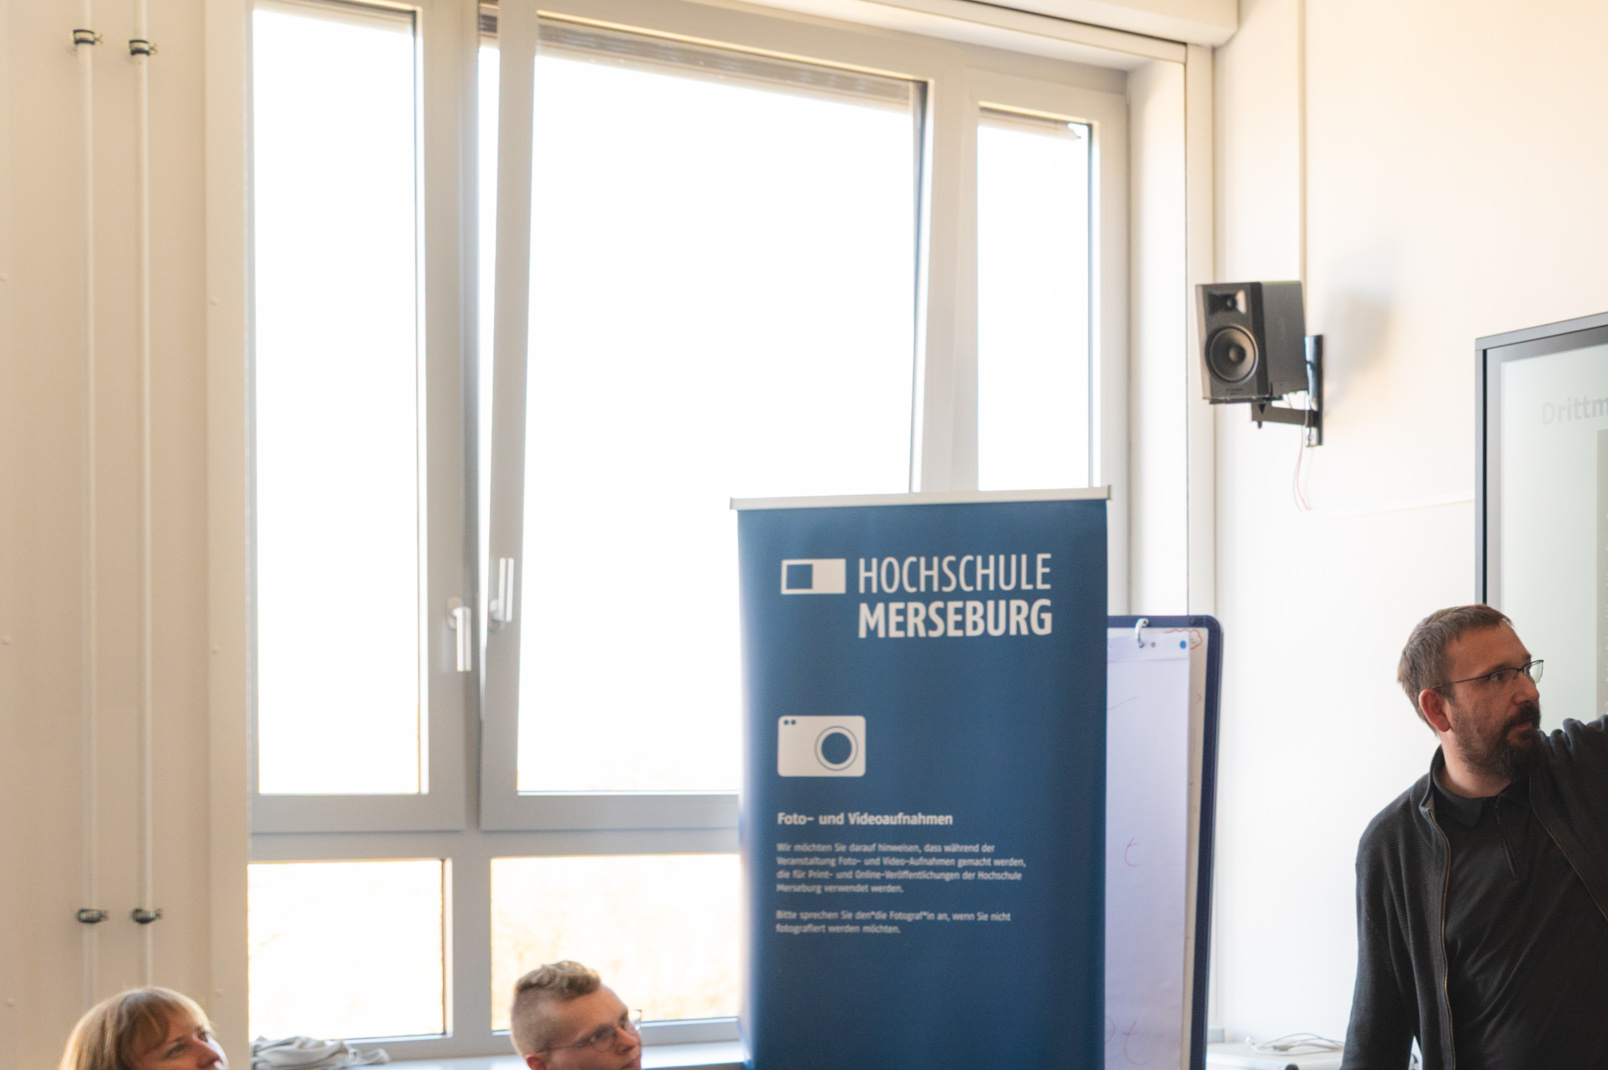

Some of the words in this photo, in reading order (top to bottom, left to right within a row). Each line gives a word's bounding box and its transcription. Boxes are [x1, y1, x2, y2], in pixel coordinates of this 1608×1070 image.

[858, 553, 1052, 594] HOCHSCHULE
[858, 598, 1053, 639] MERSEBURG
[777, 812, 815, 826] Foto-
[818, 811, 845, 825] und
[848, 811, 953, 826] Videoaufnahmen
[776, 842, 792, 852] Wir
[793, 842, 833, 853] möchten
[834, 842, 847, 853] Sie
[848, 842, 877, 853] darauf
[923, 843, 942, 853] dass
[943, 842, 980, 853] während
[981, 842, 996, 853] der
[776, 856, 837, 868] Veranstaltung
[838, 856, 862, 866] Foto-
[863, 856, 881, 866] und
[882, 856, 956, 867] Video-Aufnahmen
[957, 857, 992, 869] gemacht
[993, 857, 1027, 868] werden,
[776, 869, 791, 879] die
[792, 869, 807, 879] für
[807, 869, 834, 879] Print-
[835, 869, 854, 880] und
[854, 869, 960, 882] Online-Veröffentlichungen
[961, 870, 976, 880] der
[977, 870, 1023, 881] Hochschule
[775, 883, 822, 895] Merseburg
[823, 883, 869, 893] verwendet
[870, 884, 905, 893] werden.
[775, 909, 798, 920] Bitte
[799, 910, 839, 921] sprechen
[840, 910, 853, 920] Sie
[936, 912, 951, 922] an,
[951, 912, 976, 921] wenn
[976, 911, 989, 921] Sie
[990, 911, 1012, 921] nicht
[775, 923, 827, 935] fotografiert
[827, 923, 860, 933] werden
[861, 923, 902, 934] möchten.
